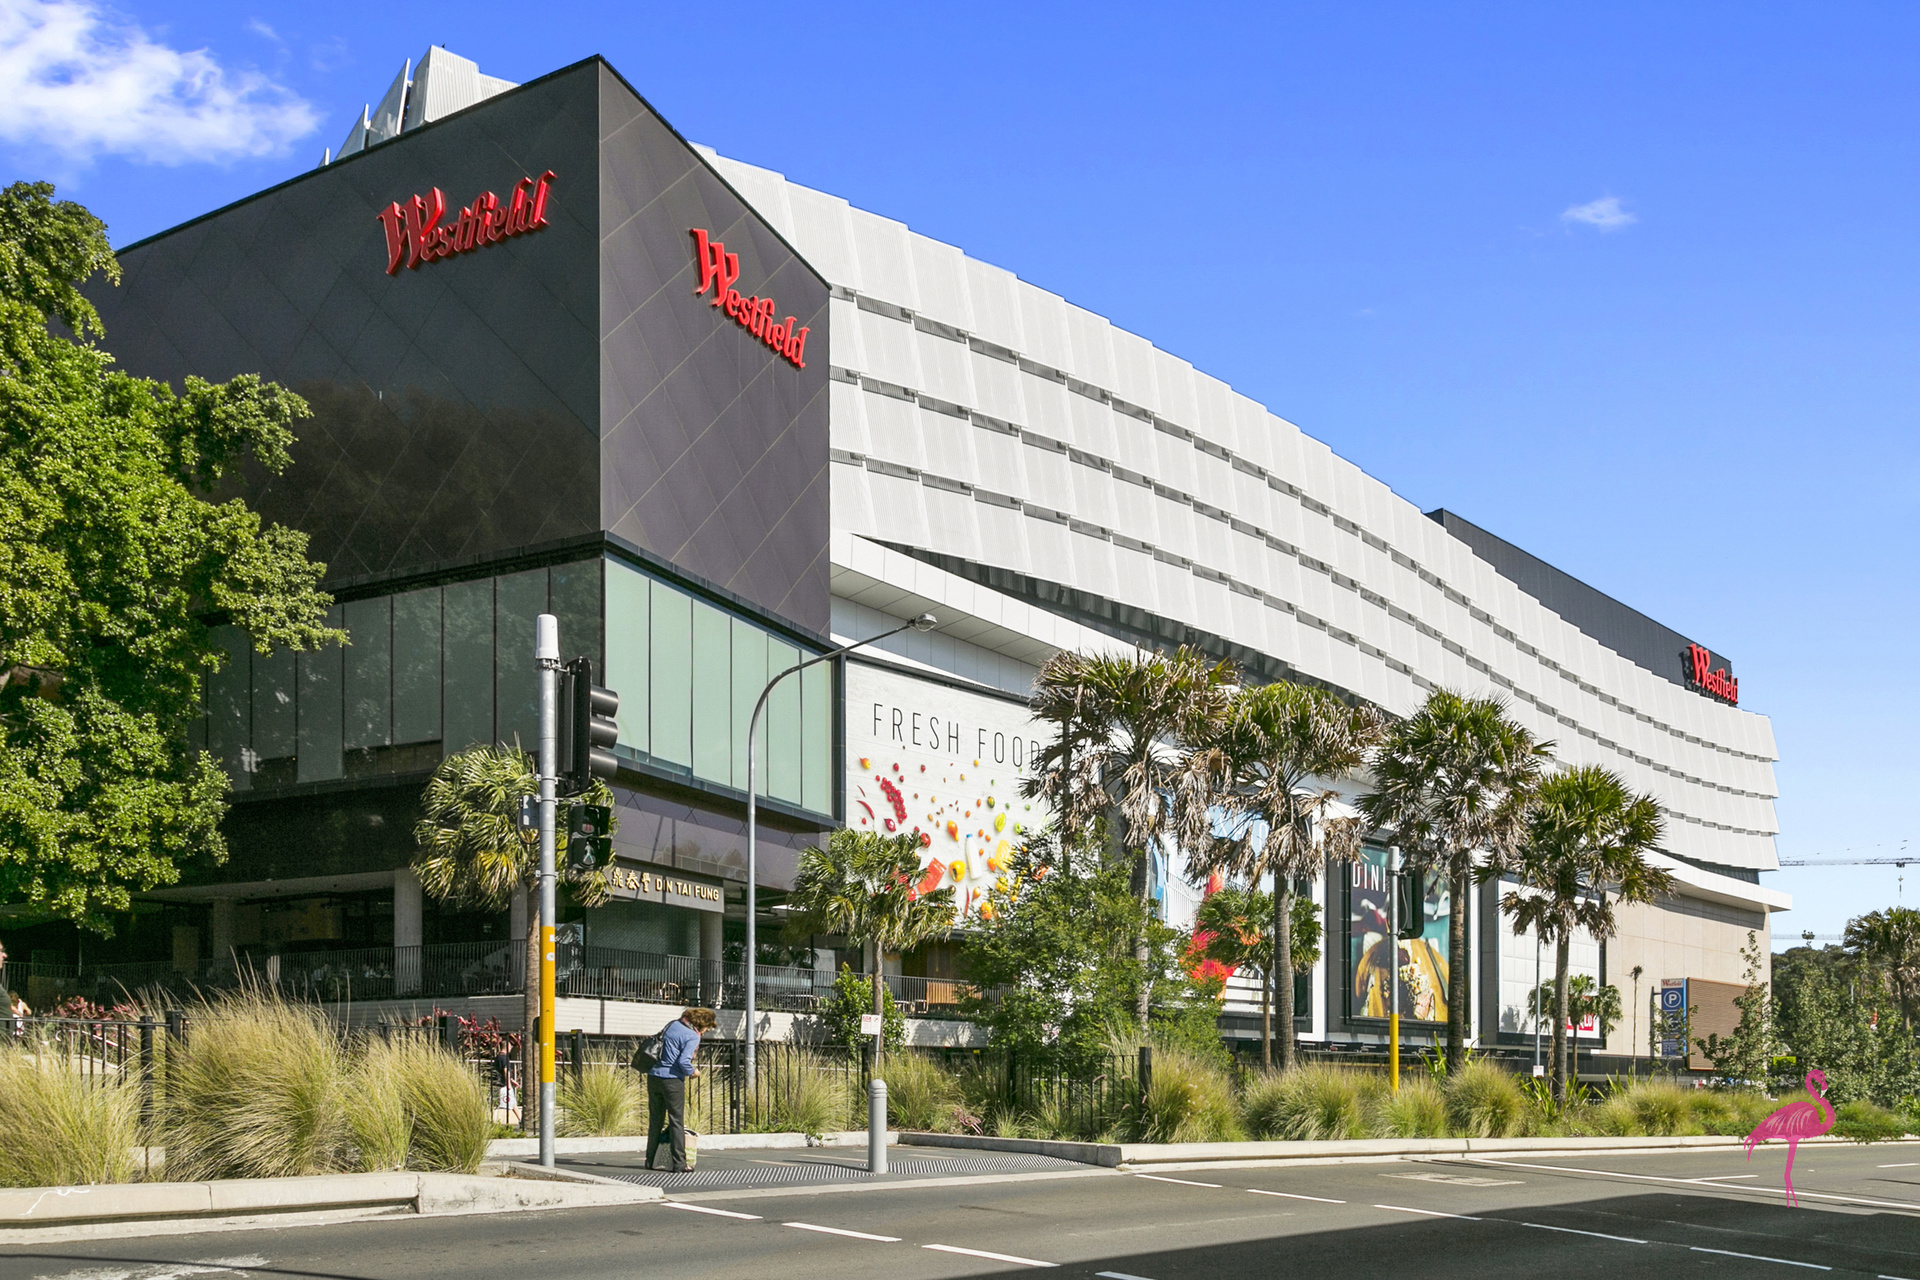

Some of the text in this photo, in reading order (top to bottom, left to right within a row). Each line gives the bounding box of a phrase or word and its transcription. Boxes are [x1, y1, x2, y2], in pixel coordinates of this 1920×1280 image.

[376, 169, 558, 275] Westfield
[690, 228, 811, 369] Westfield
[1687, 643, 1739, 704] Westfield
[873, 703, 1041, 771] FRESH FOOD
[655, 878, 720, 901] DIN TAI FUNG
[1668, 994, 1677, 1005] P
